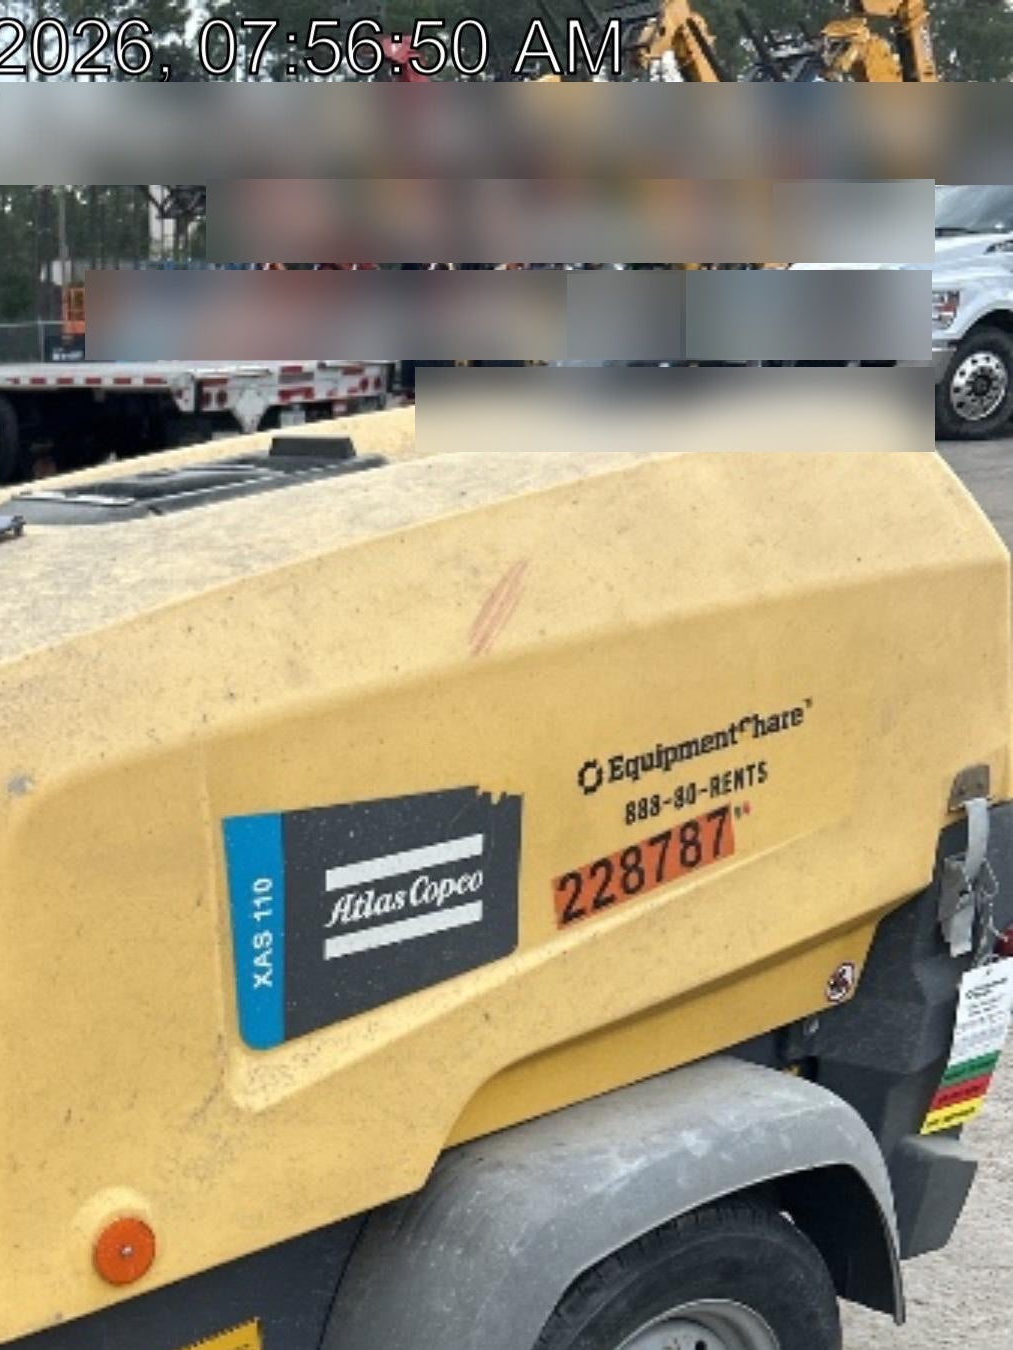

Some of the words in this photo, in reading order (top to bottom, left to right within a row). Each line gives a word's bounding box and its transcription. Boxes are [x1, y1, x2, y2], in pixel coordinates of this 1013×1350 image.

[625, 761, 768, 825] 888-80-RENTS
[557, 804, 731, 925] 228787
[252, 878, 273, 922] 110
[324, 886, 406, 929] Atlas
[409, 869, 484, 908] Copco
[252, 930, 273, 988] XAS
